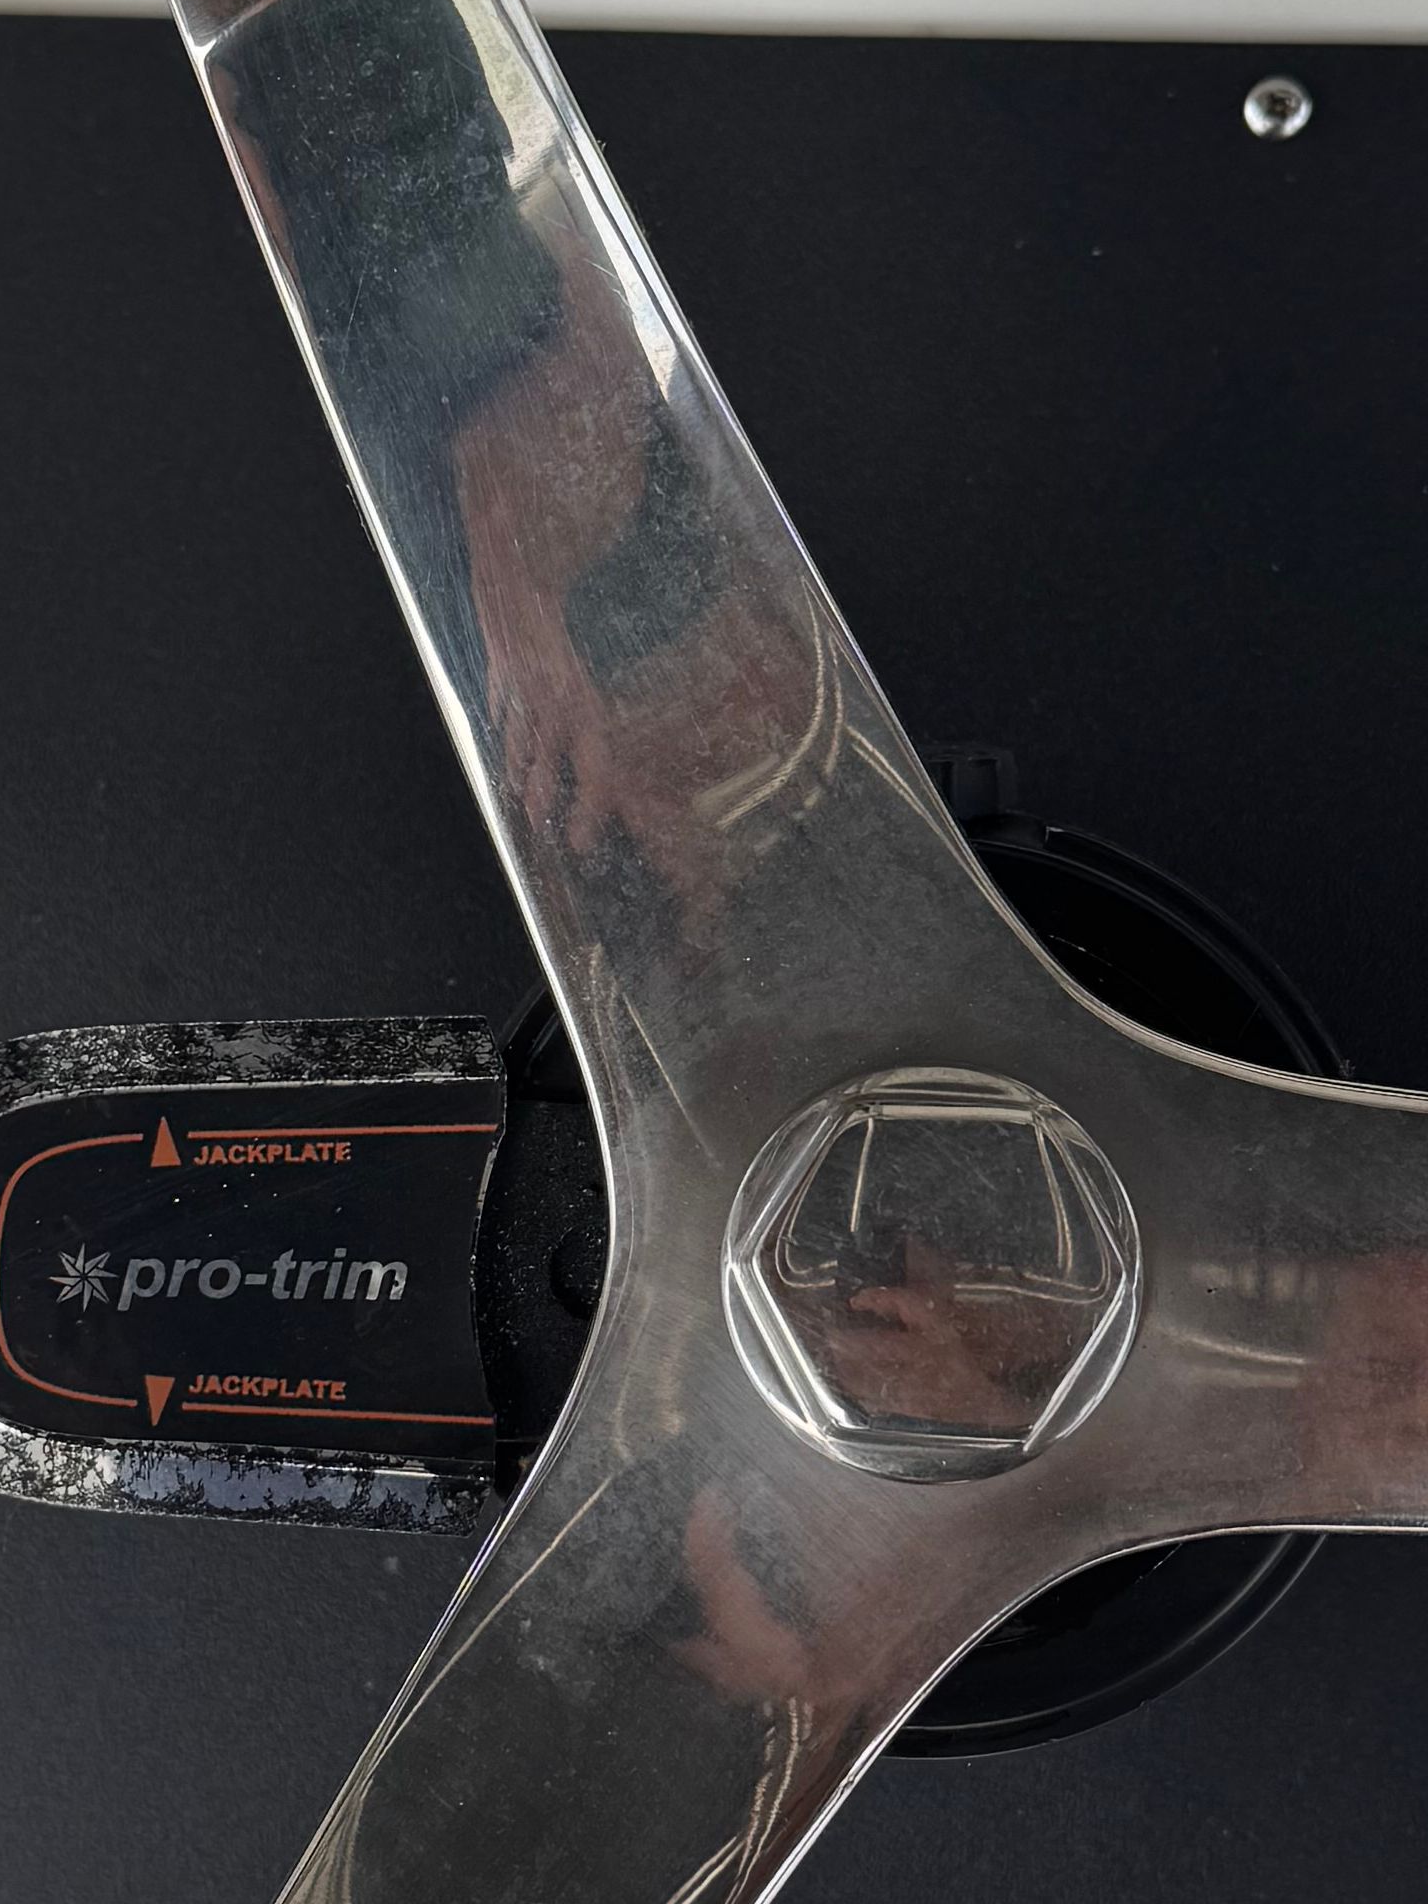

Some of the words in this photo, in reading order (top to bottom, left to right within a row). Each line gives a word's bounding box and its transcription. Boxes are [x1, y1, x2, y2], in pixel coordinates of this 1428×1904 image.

[193, 1141, 352, 1166] JACKPLATE
[117, 1247, 409, 1312] pro-trim
[188, 1374, 347, 1401] JACKPLATE
